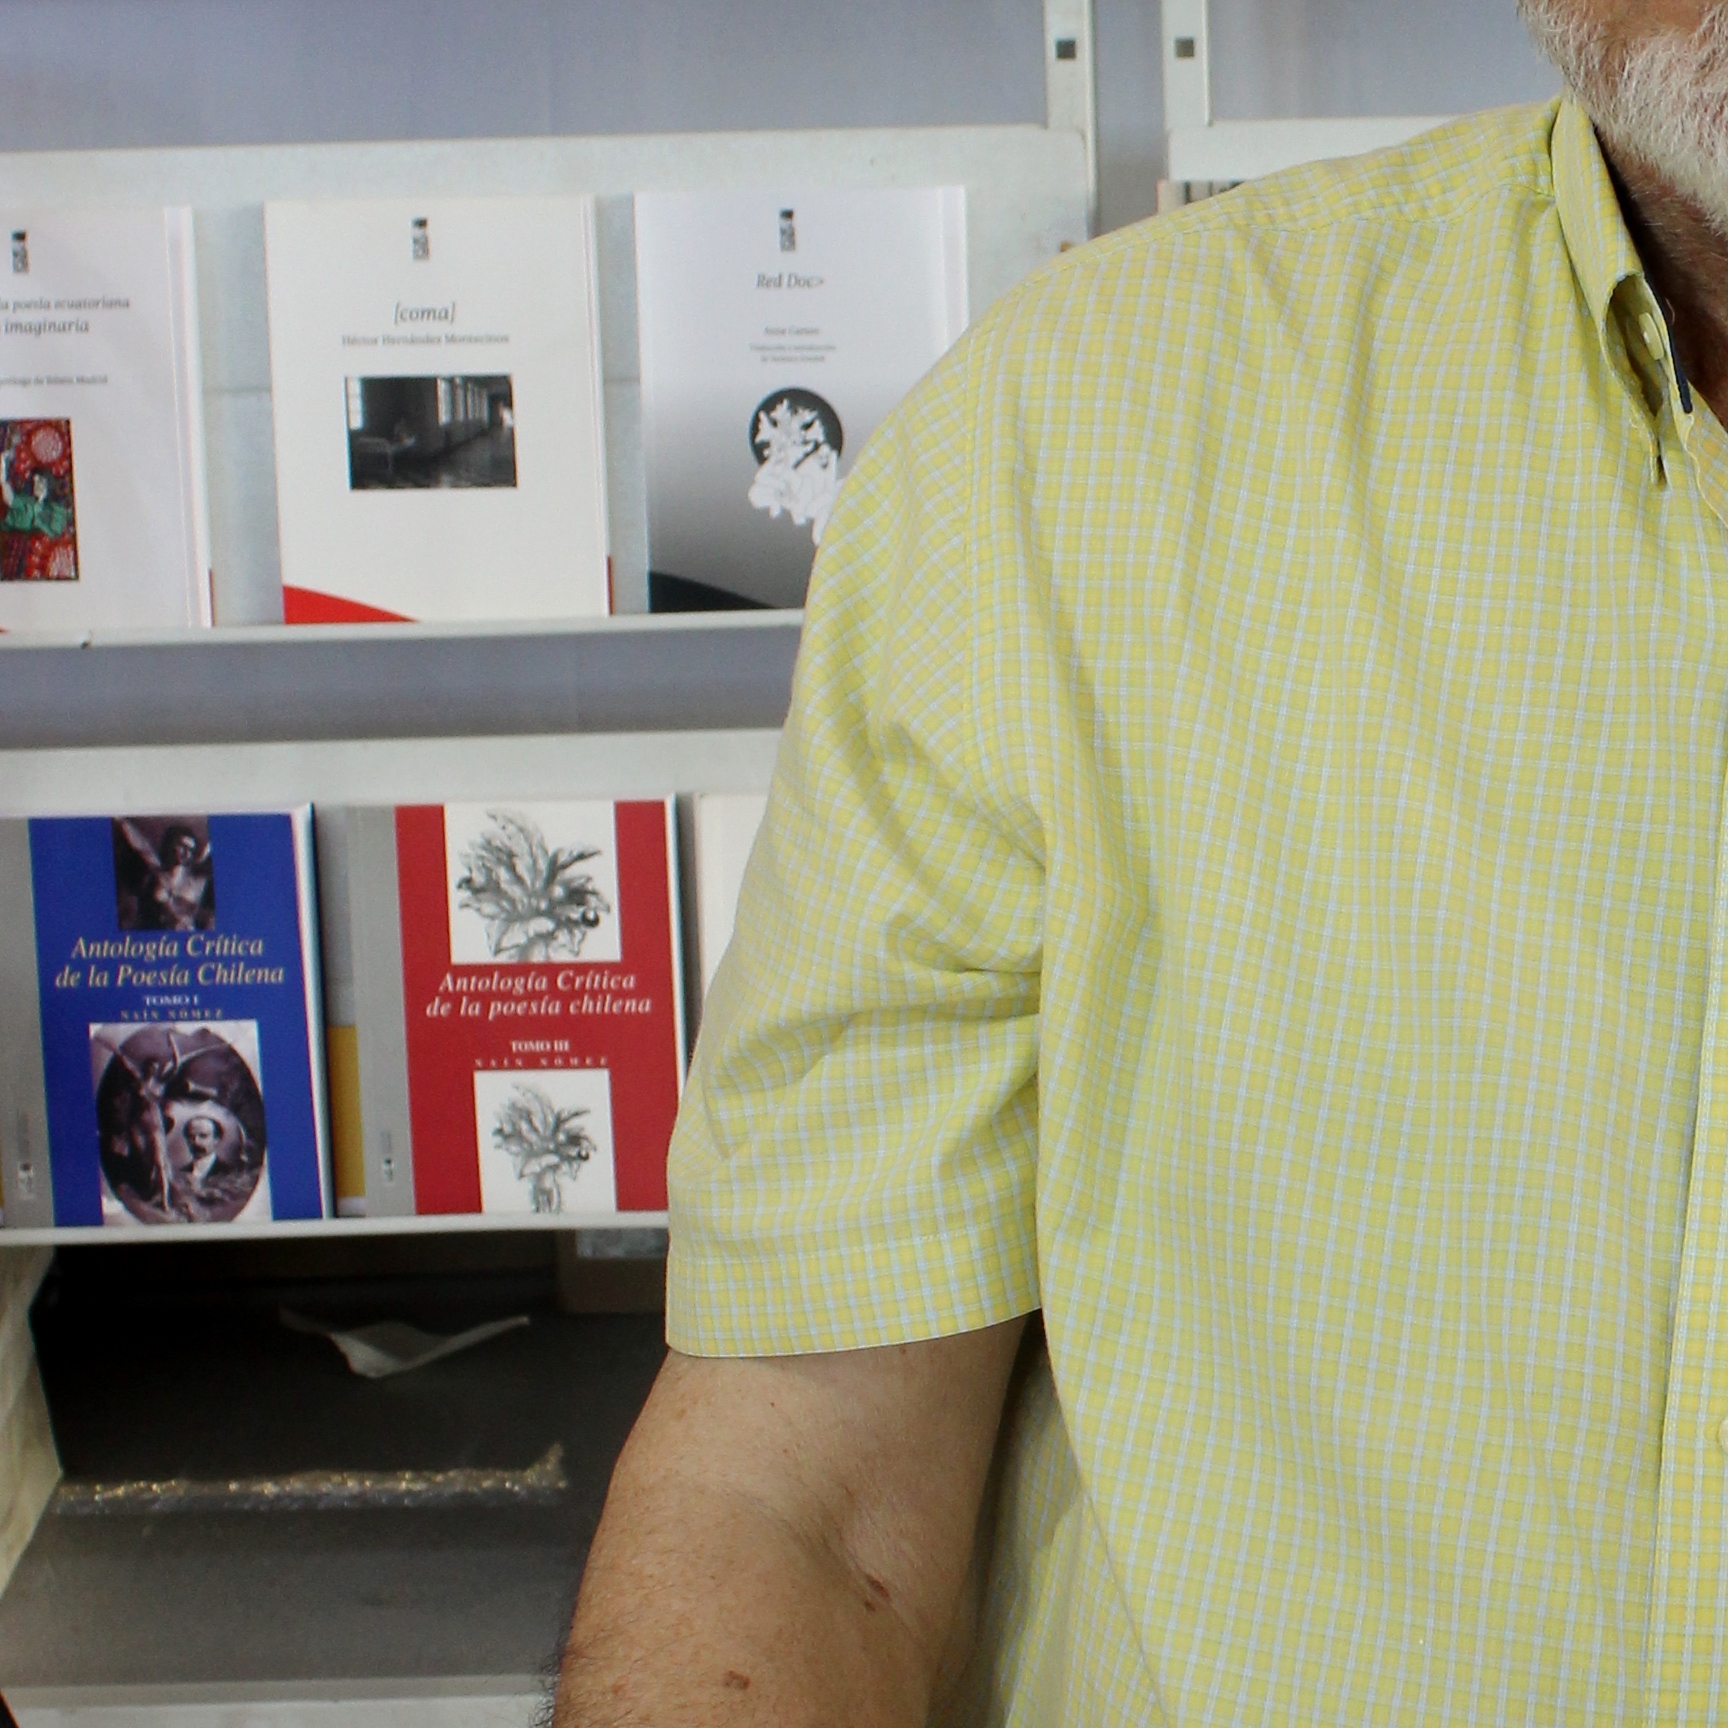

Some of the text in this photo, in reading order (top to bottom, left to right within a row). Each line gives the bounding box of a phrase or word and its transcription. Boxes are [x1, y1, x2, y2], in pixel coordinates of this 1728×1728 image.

[757, 273, 783, 288] Red
[54, 295, 130, 310] ecuatoriana
[393, 301, 456, 326] [coma]
[4, 317, 90, 336] imaginaria
[70, 932, 264, 962] Antología Crítica
[55, 961, 285, 988] de la Poesía Chilena
[438, 968, 636, 996] Antología Crítica
[143, 995, 190, 1006] TOMO
[425, 993, 652, 1022] de la poesía chilena
[510, 1039, 570, 1053] TOMO III
